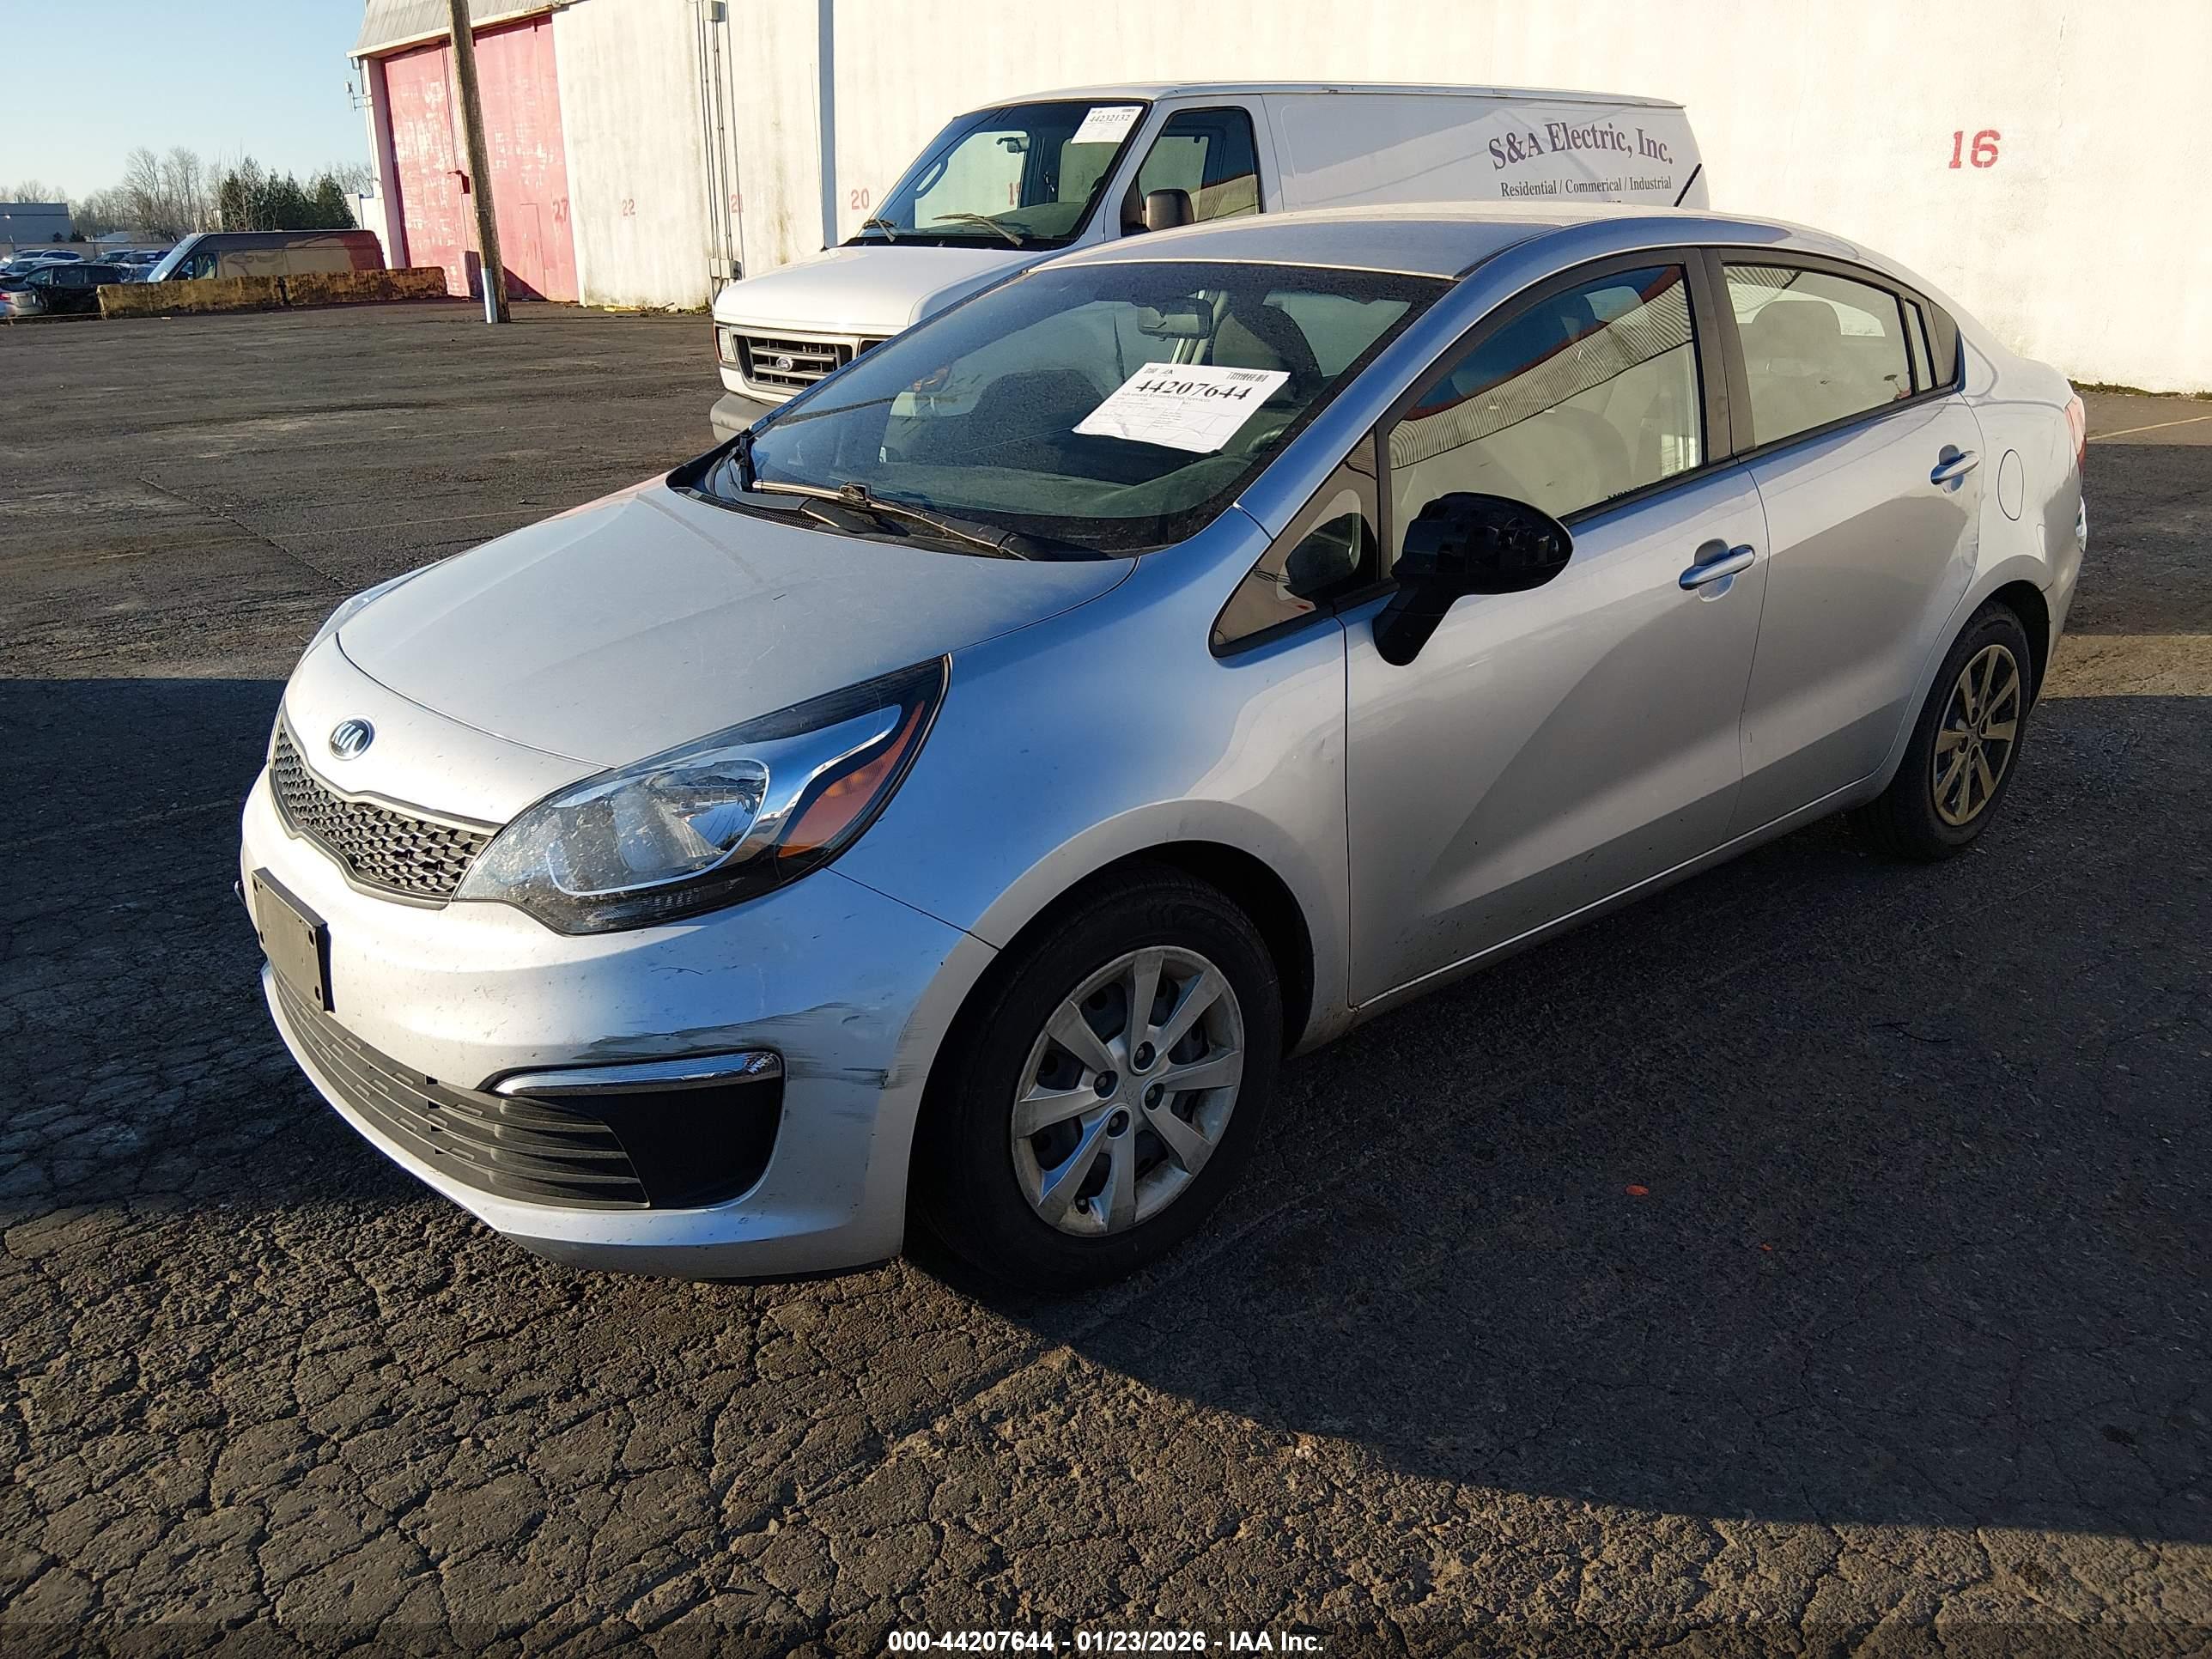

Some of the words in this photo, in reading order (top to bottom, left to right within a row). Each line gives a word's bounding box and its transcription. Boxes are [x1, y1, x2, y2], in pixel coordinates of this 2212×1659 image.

[1488, 131, 1545, 172] S&A
[1544, 121, 1632, 159] Electric,
[1636, 127, 1674, 165] Inc.
[1948, 130, 2001, 169] 16
[1500, 179, 1558, 198] Residential
[1565, 178, 1622, 194] Commerical
[1630, 175, 1672, 191] Industrial
[622, 198, 636, 217] 22
[850, 188, 870, 210] 20
[1135, 380, 1254, 401] 44207644
